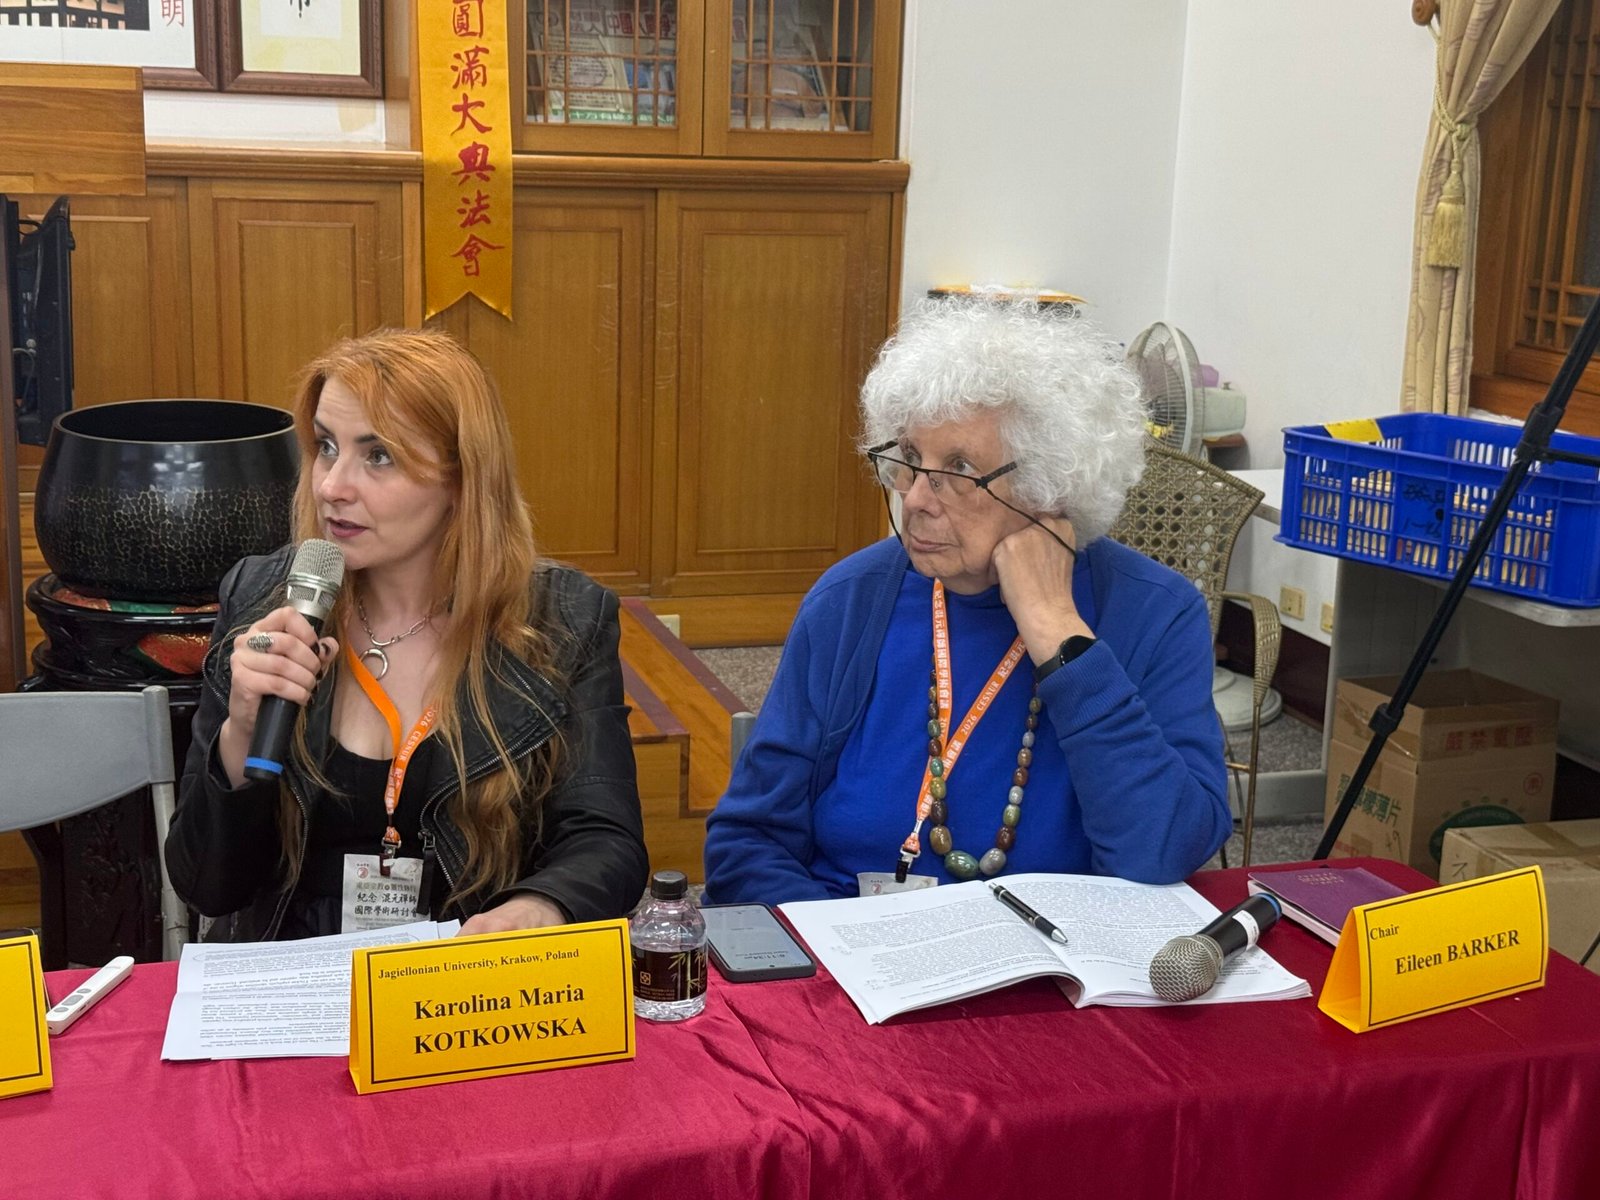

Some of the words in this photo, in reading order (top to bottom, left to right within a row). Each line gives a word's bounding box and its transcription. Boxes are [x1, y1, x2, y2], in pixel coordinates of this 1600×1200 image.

[161, 0, 185, 27] 明
[451, 0, 505, 277] 圓滿大典法會
[961, 715, 978, 736] 2026
[976, 681, 999, 712] CESNUR
[399, 730, 422, 761] CESNUR
[1370, 923, 1400, 942] Chair
[378, 963, 440, 981] Jagiellonian
[443, 957, 498, 971] University,
[500, 952, 543, 967] Krakow,
[545, 948, 580, 961] Poland
[1395, 953, 1442, 975] Eileen
[1447, 929, 1520, 963] BARKER
[414, 993, 511, 1021] Karolina
[519, 984, 585, 1008] Maria
[413, 1017, 587, 1055] KOTKOWSKA
